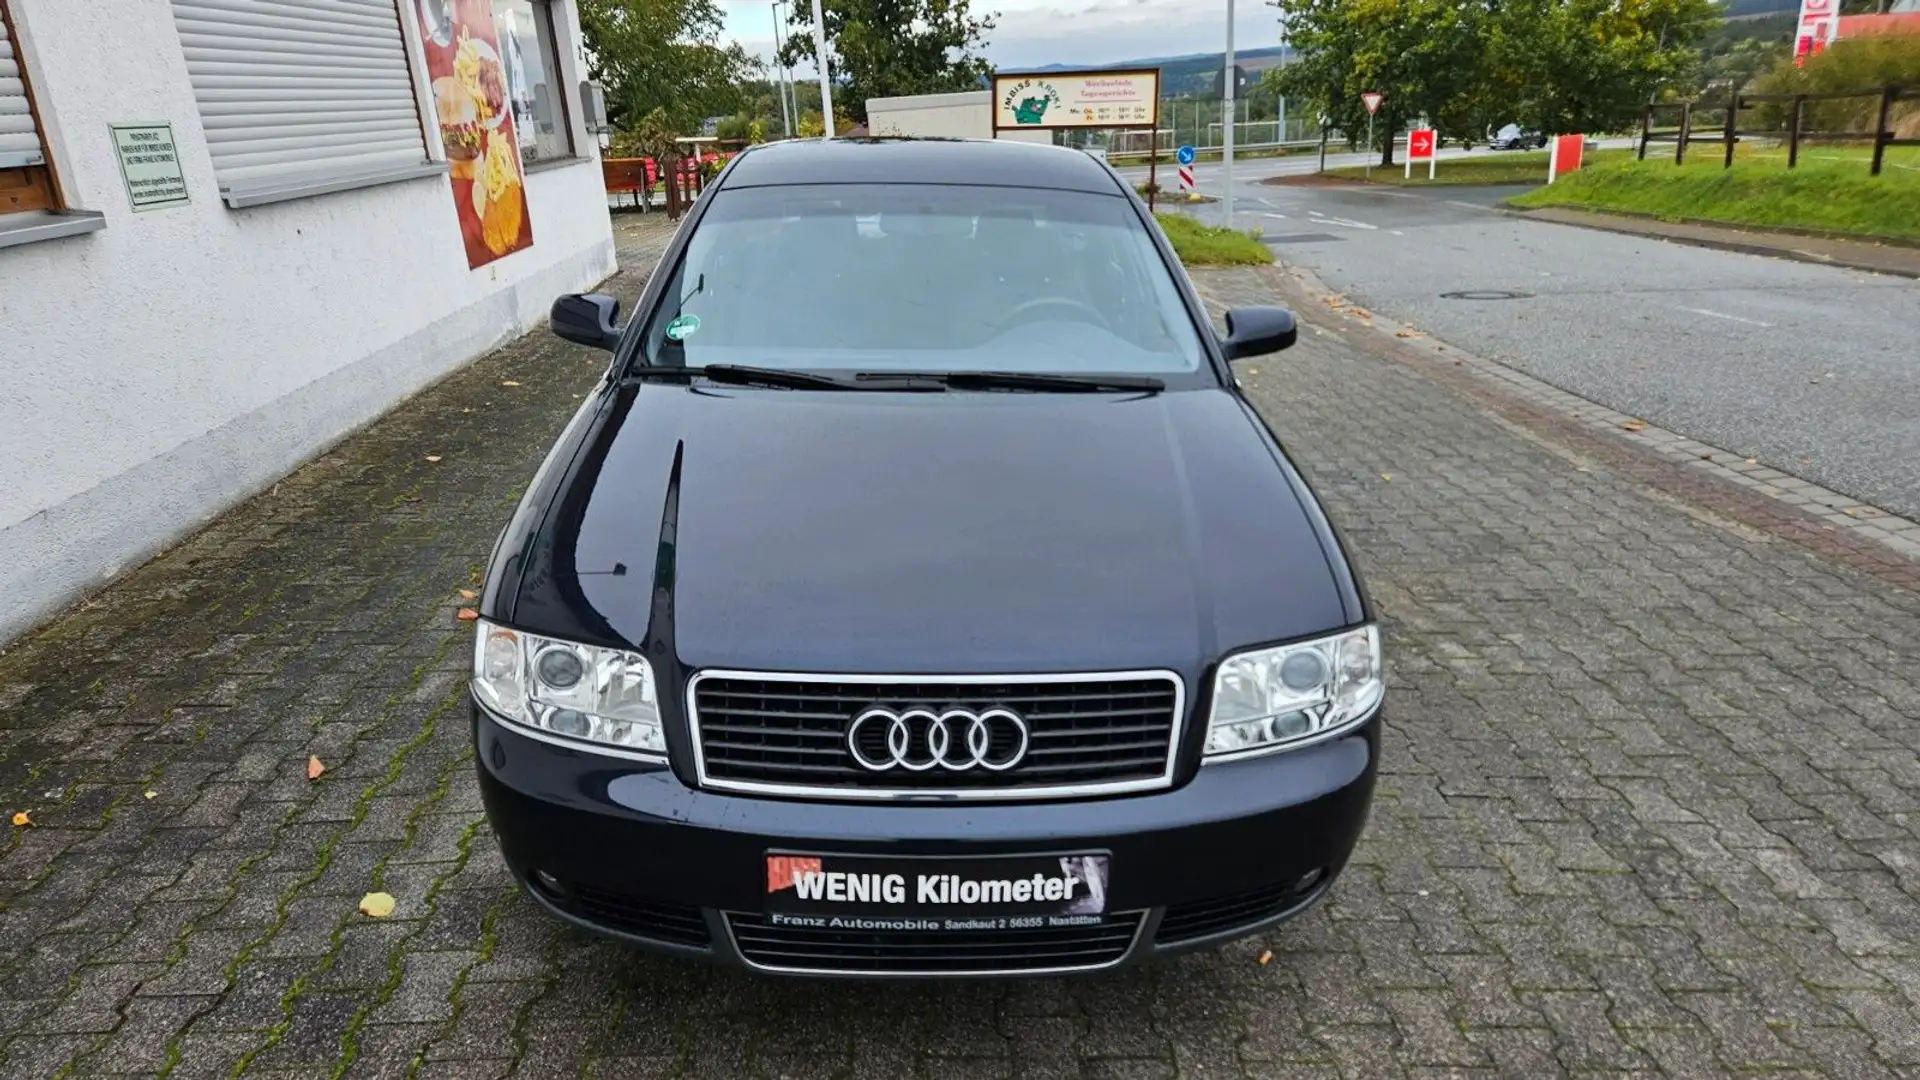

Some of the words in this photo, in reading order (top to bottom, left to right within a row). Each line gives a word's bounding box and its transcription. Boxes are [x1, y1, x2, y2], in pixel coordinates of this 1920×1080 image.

[1004, 79, 1031, 110] IMBISS
[792, 871, 906, 904] WENIG
[916, 872, 1080, 904] Kilometer
[771, 913, 826, 927] Franz
[829, 917, 940, 930] Automobile
[998, 919, 1007, 929] 2
[1010, 917, 1043, 928] 56355
